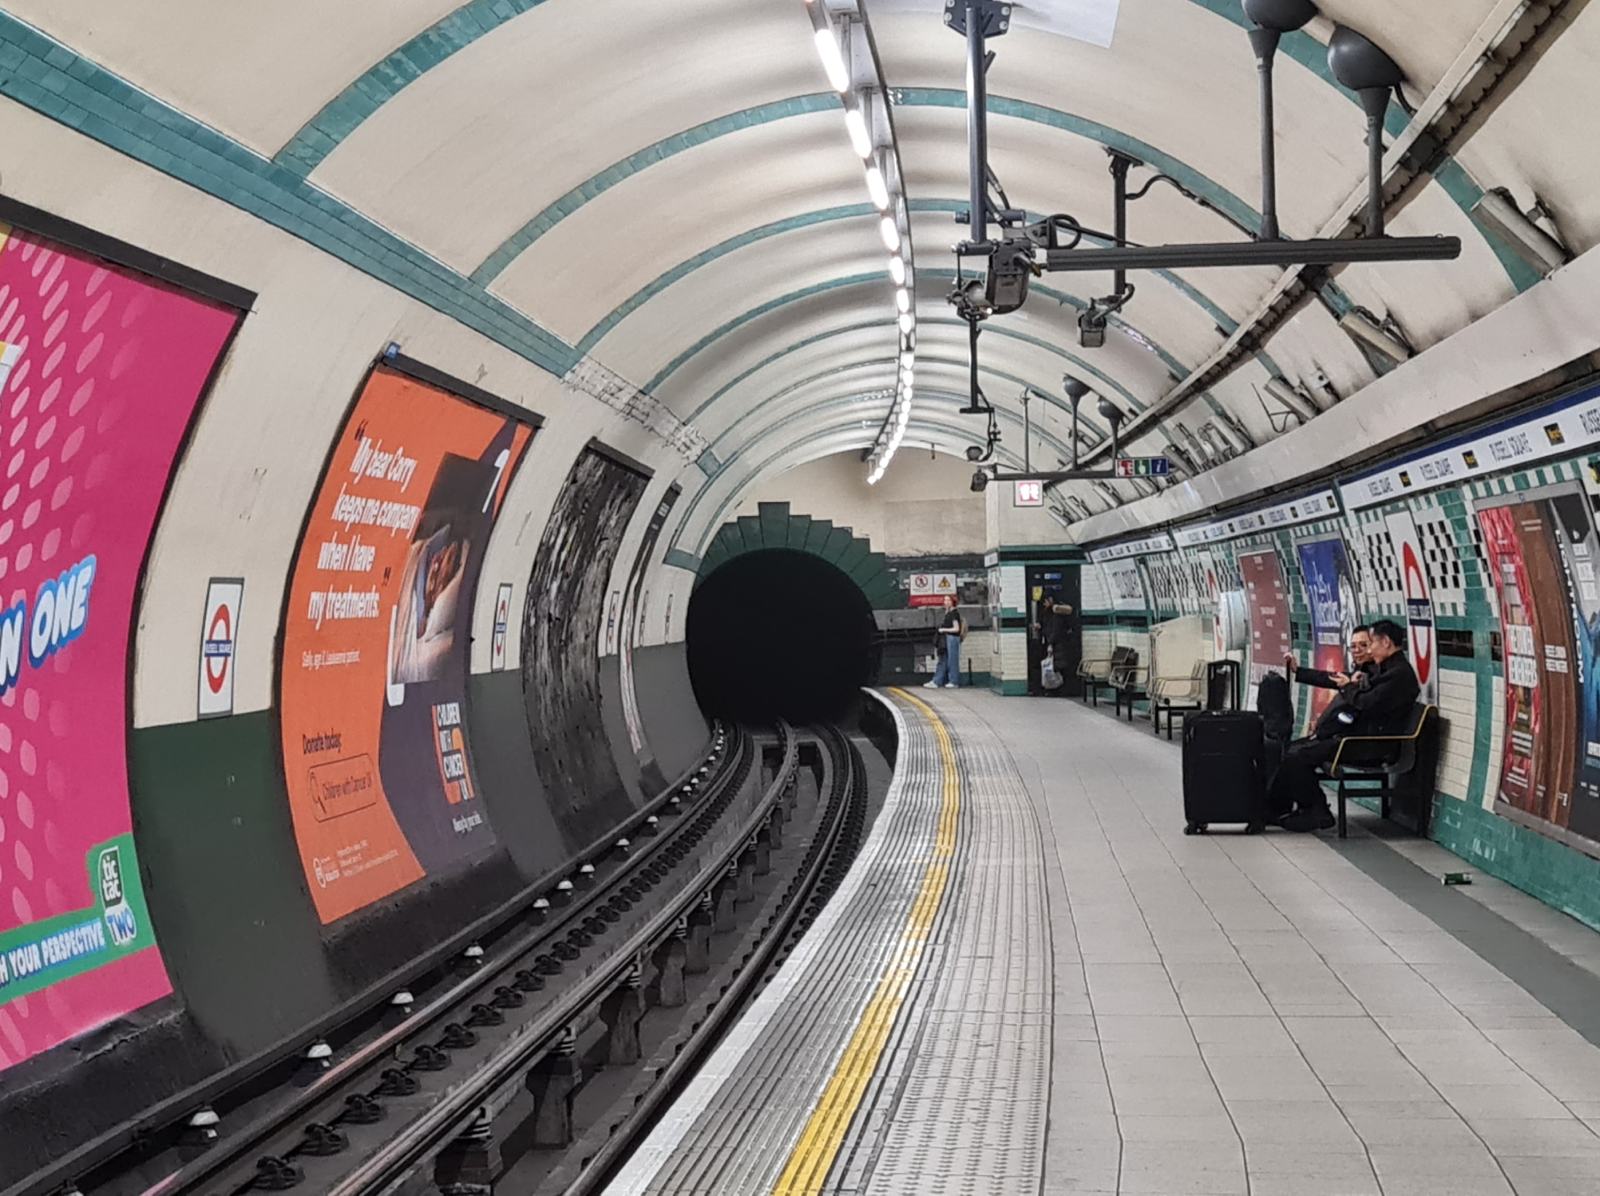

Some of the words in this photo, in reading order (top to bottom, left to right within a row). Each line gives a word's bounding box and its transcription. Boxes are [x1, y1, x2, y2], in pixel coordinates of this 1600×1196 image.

[331, 482, 367, 532] keeps
[360, 498, 380, 525] me
[376, 501, 421, 538] company
[317, 531, 349, 571] when
[349, 534, 376, 572] have
[29, 560, 95, 664] ONE
[307, 591, 328, 630] my
[1555, 529, 1584, 684] LIGHTROOM
[101, 855, 119, 880] tic
[102, 878, 122, 902] tac
[106, 908, 136, 946] TWO
[9, 943, 42, 978] YOUR
[41, 920, 105, 967] PERSPECTIVE
